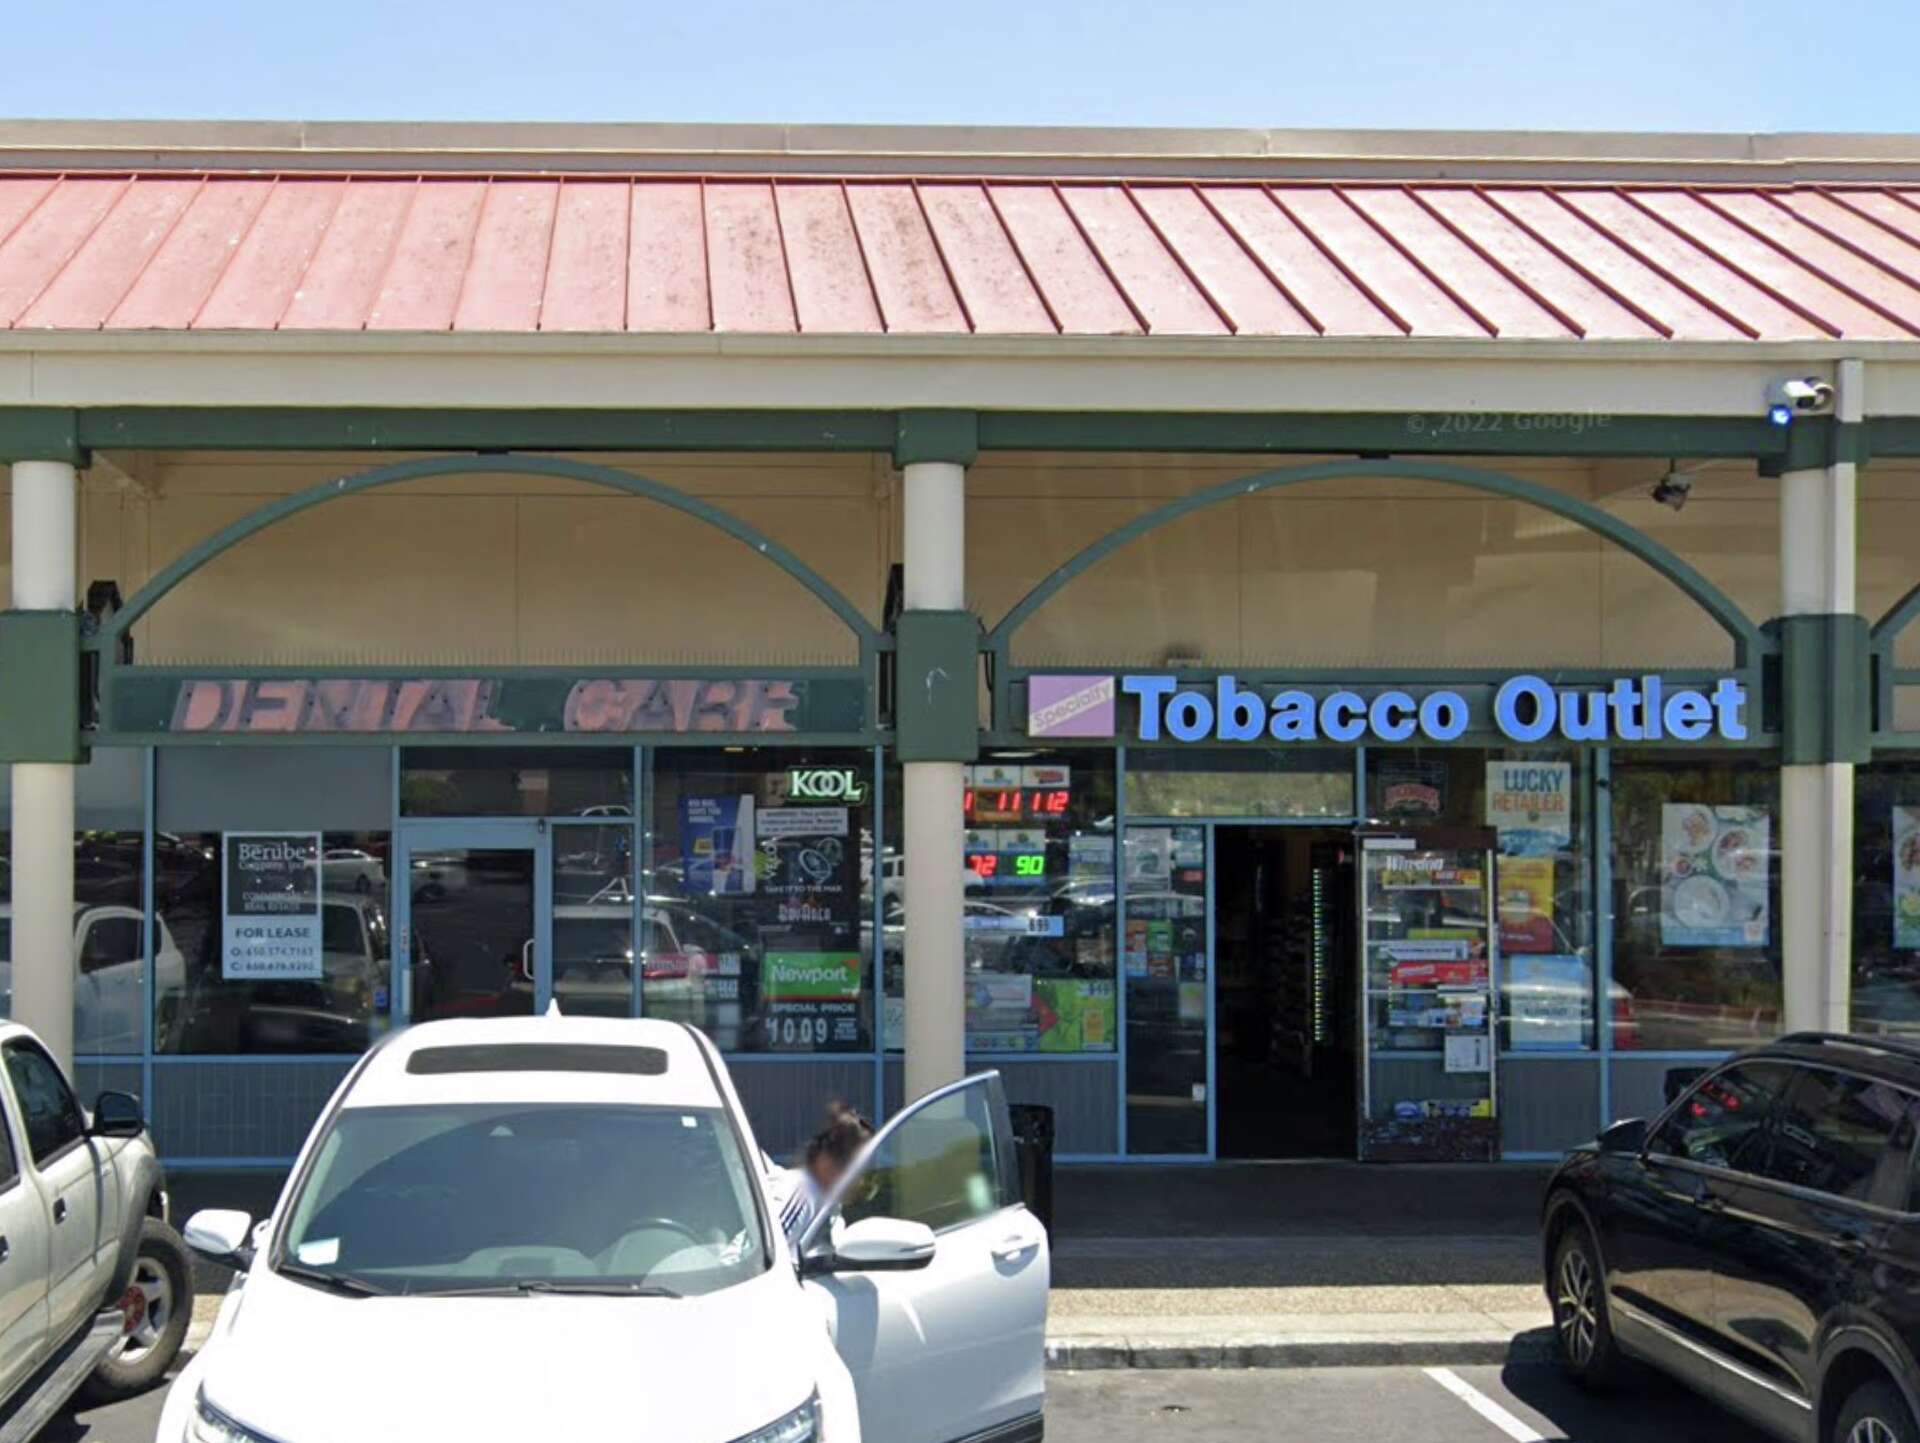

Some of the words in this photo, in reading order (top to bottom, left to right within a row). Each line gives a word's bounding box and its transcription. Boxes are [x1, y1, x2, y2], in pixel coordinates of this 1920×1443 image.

[1033, 683, 1110, 728] Specialty
[1122, 675, 1469, 742] Tobacco
[1494, 675, 1747, 742] Outlet
[791, 770, 862, 797] KOOL
[1504, 769, 1563, 792] LUCKY
[239, 841, 307, 861] Berube
[1016, 855, 1044, 875] 90
[235, 927, 264, 938] FOR
[267, 927, 310, 938] LEASE
[771, 966, 848, 985] Newport
[771, 1003, 818, 1013] SPECIAL
[821, 1003, 856, 1013] PRICE
